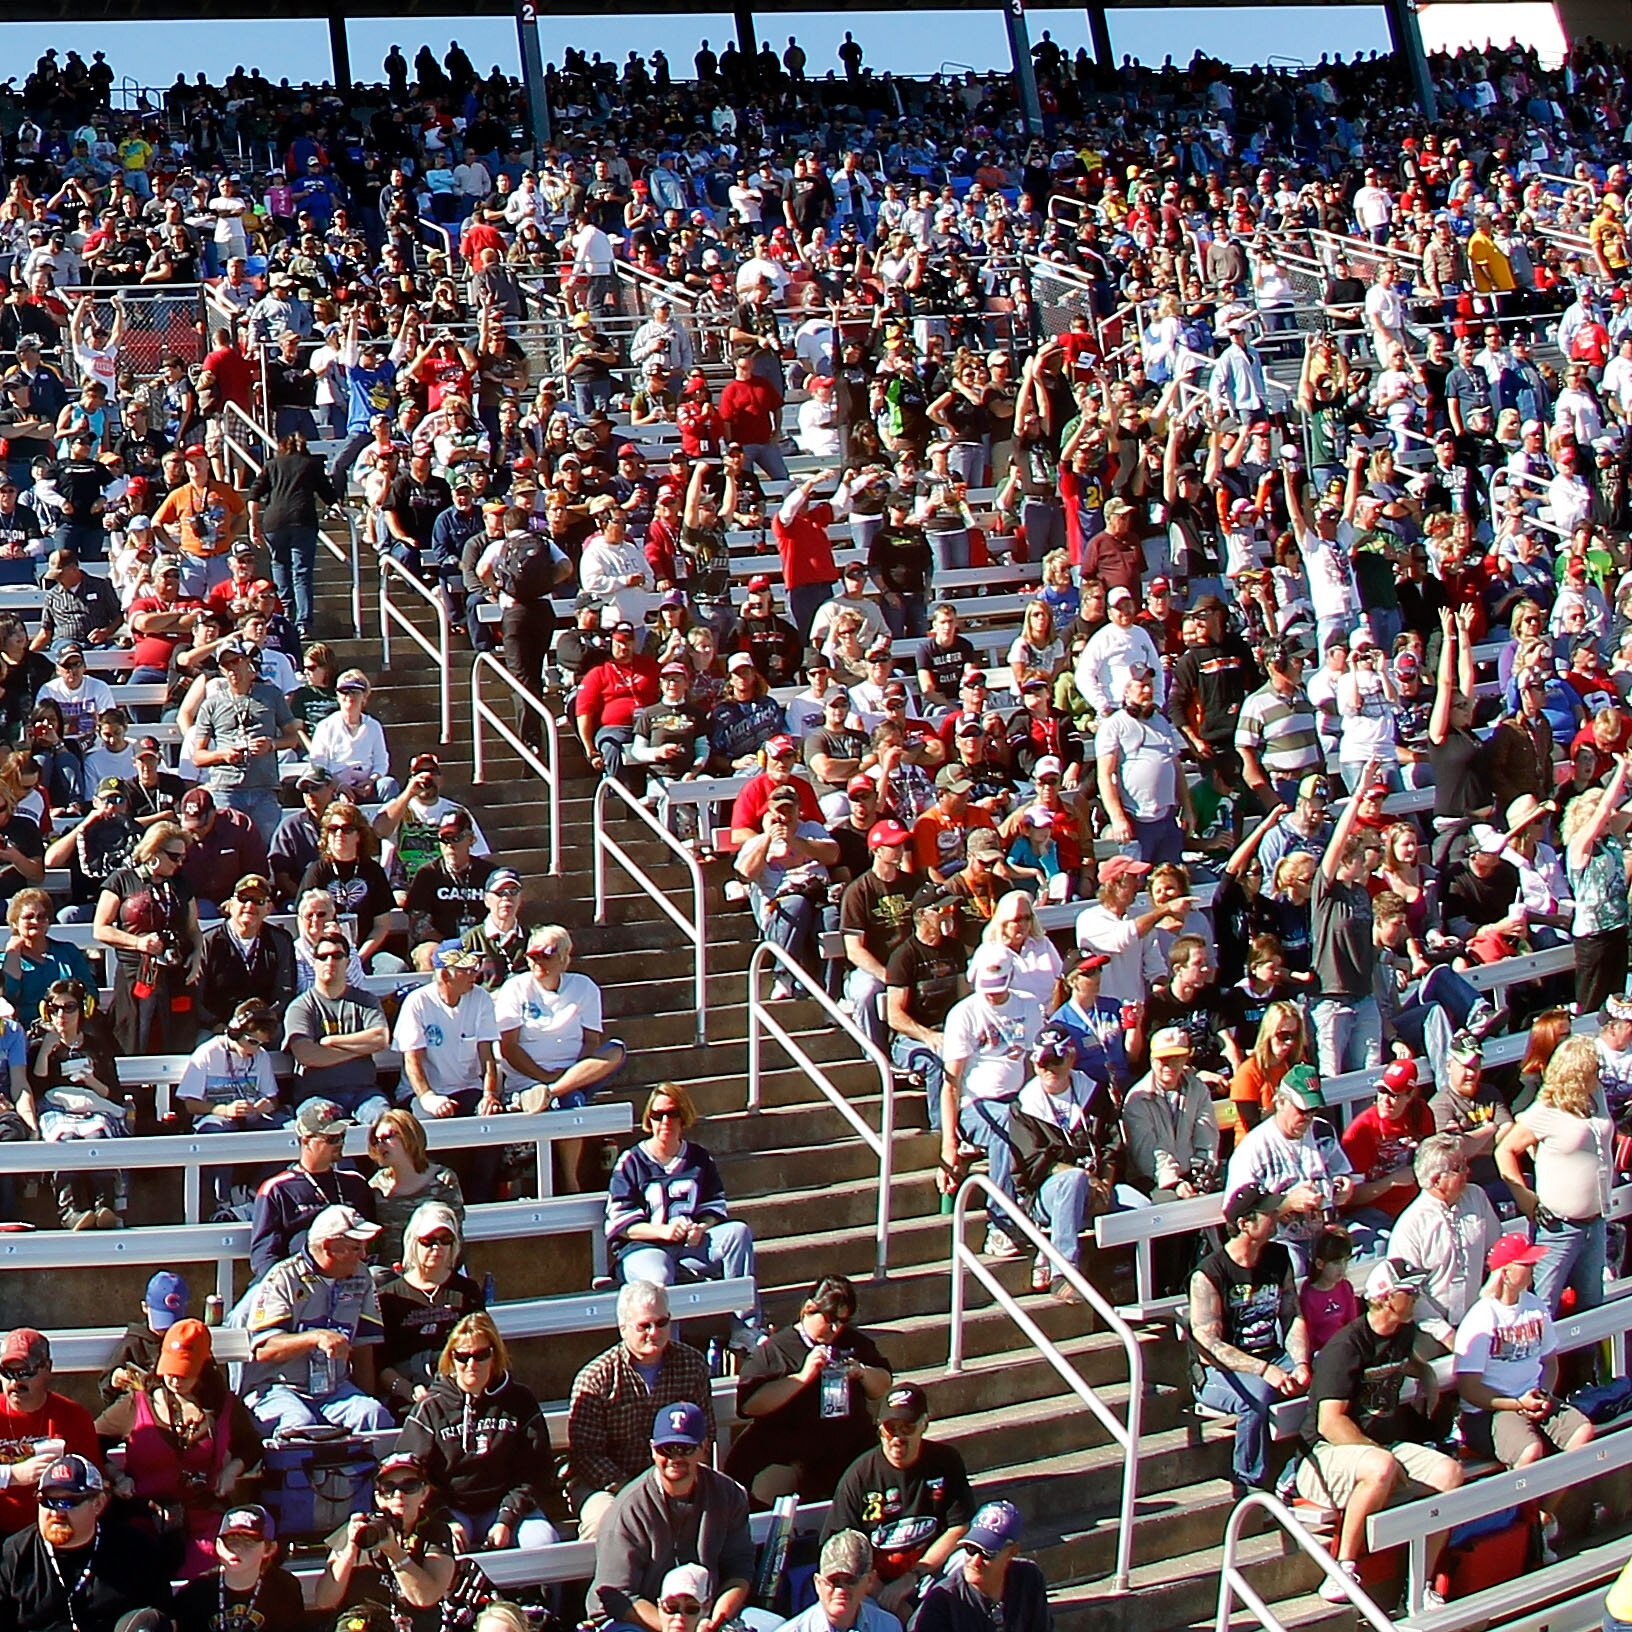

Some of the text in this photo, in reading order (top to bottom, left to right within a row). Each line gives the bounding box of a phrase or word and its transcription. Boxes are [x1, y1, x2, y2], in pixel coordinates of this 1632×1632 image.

[436, 887, 485, 901] CASH
[644, 1179, 698, 1222] 12
[669, 1411, 687, 1430] T
